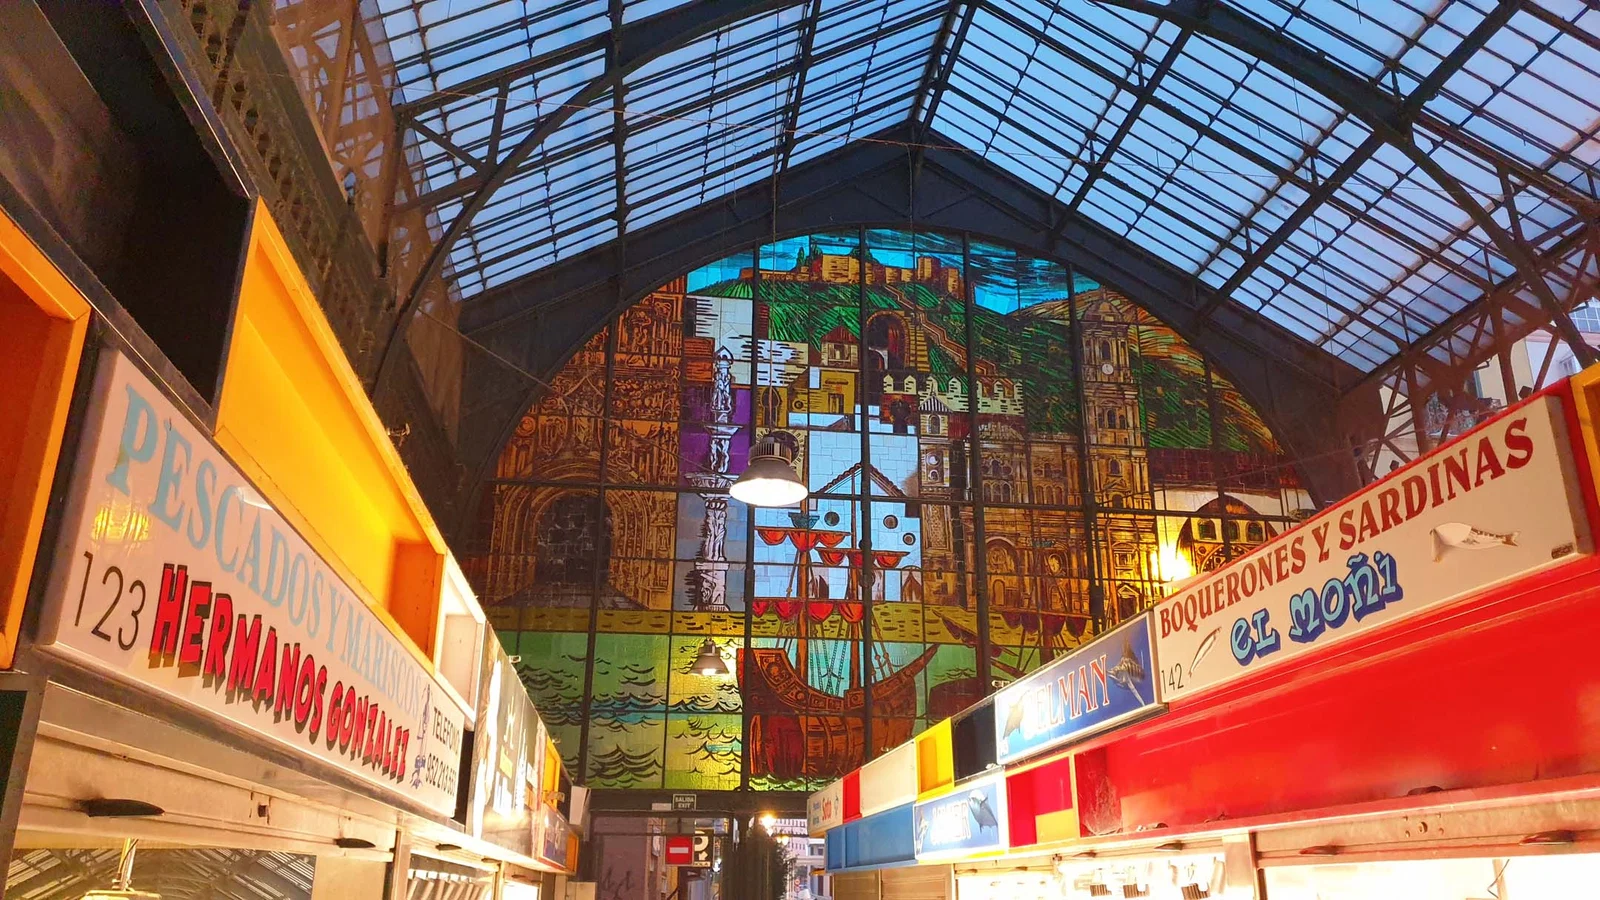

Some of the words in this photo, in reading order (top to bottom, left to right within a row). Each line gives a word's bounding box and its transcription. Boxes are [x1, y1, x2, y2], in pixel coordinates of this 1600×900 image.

[74, 551, 147, 651] 123
[105, 383, 324, 639] PESCADOS
[325, 584, 345, 653] Y
[339, 602, 421, 719] MARISCOS
[1159, 536, 1306, 639] BOQUERONES
[1312, 521, 1331, 563] Y
[1338, 417, 1534, 550] SARDINAS
[147, 563, 327, 735] HERMANOS
[327, 681, 410, 783] GONZALEZ
[1161, 663, 1184, 694] 142
